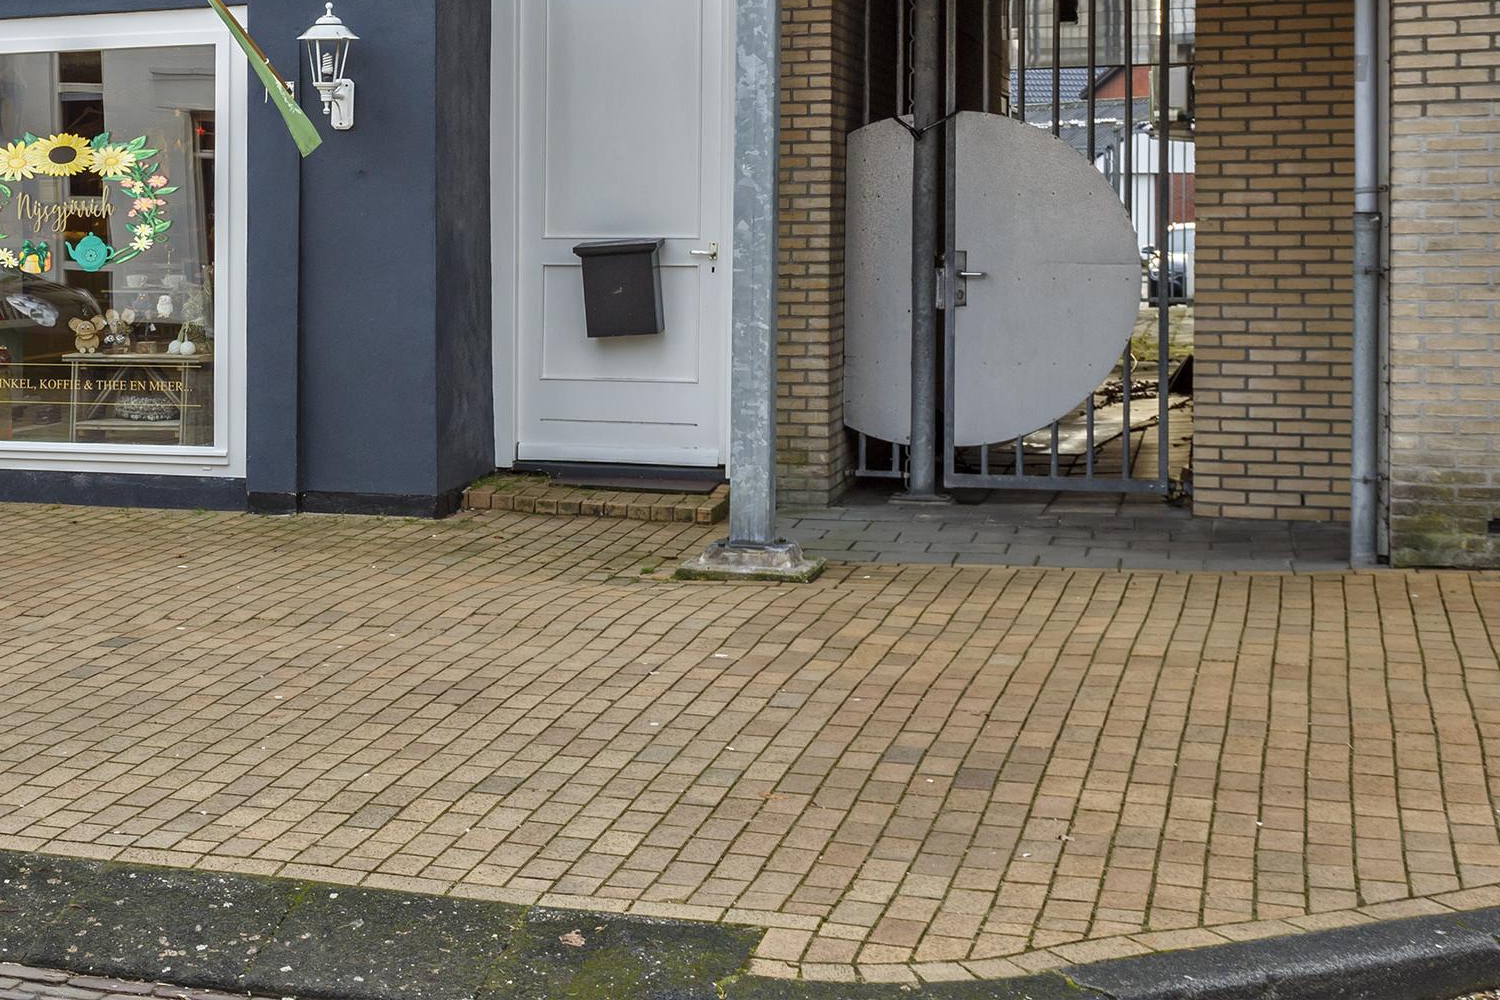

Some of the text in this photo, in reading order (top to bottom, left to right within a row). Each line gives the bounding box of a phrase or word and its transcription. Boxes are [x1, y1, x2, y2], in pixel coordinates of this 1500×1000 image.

[40, 379, 81, 390] KOFFIE
[83, 380, 93, 390] &
[96, 380, 127, 391] THEE
[130, 380, 146, 391] EN
